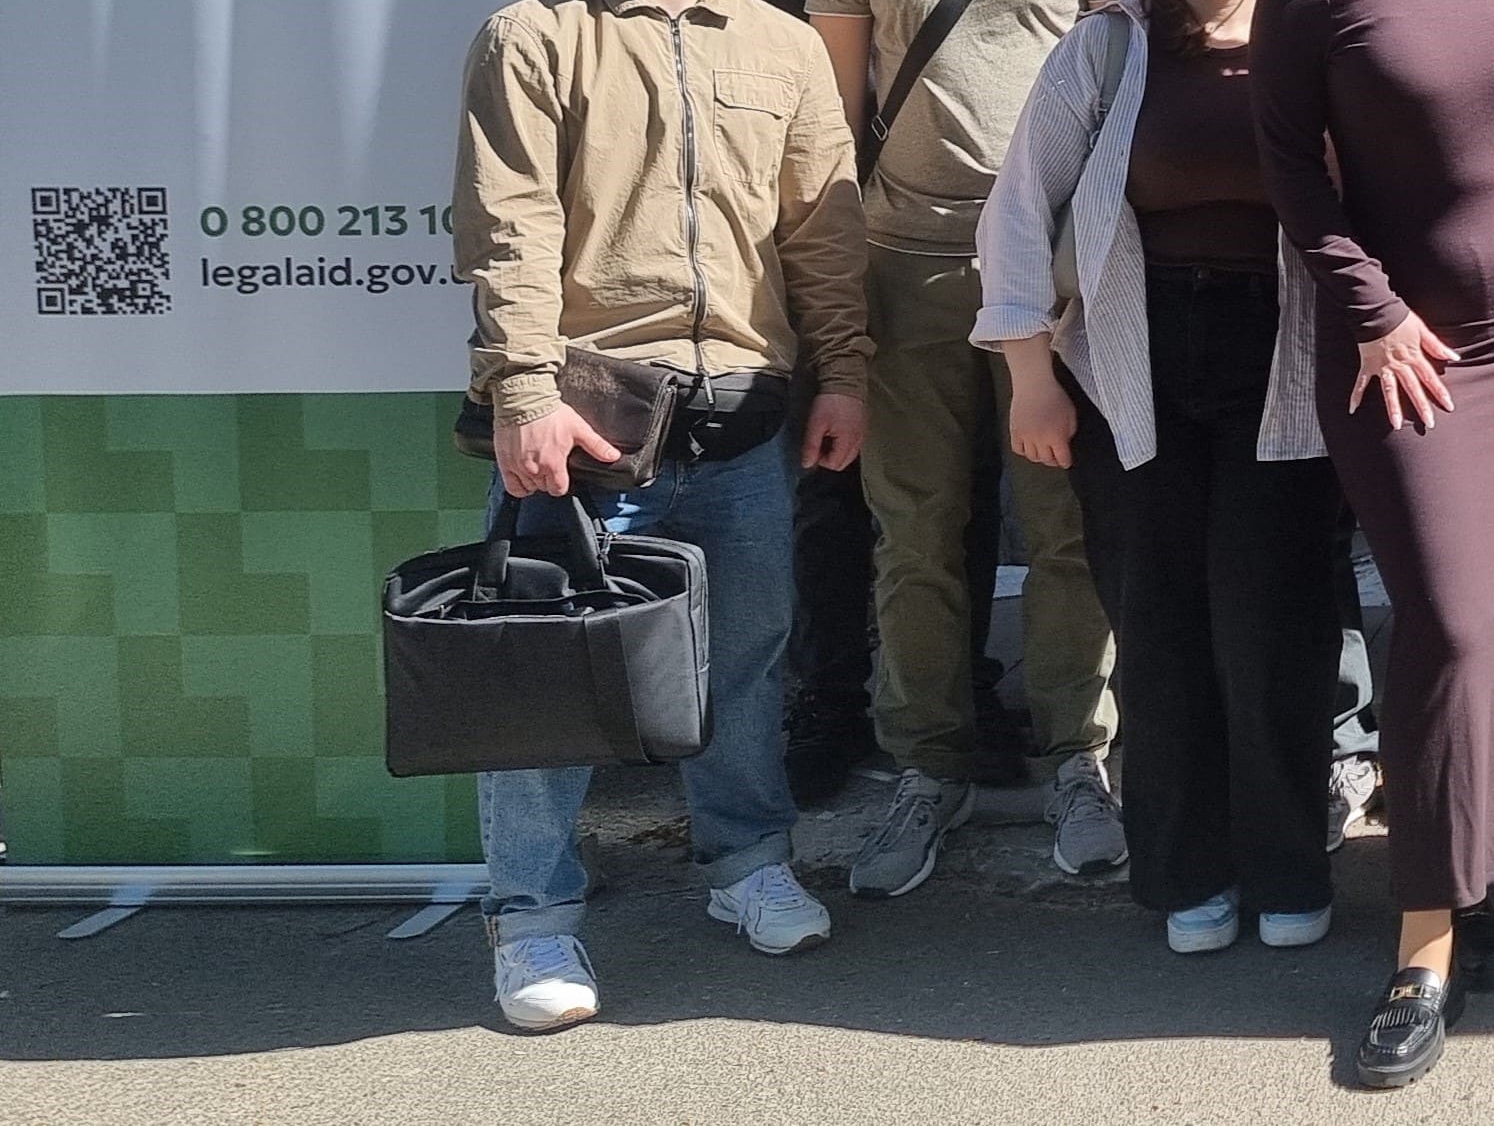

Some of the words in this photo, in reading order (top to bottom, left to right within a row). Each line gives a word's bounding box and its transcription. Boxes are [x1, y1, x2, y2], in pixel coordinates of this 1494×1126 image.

[200, 205, 228, 237] 0
[241, 205, 325, 237] 800
[337, 205, 409, 236] 213
